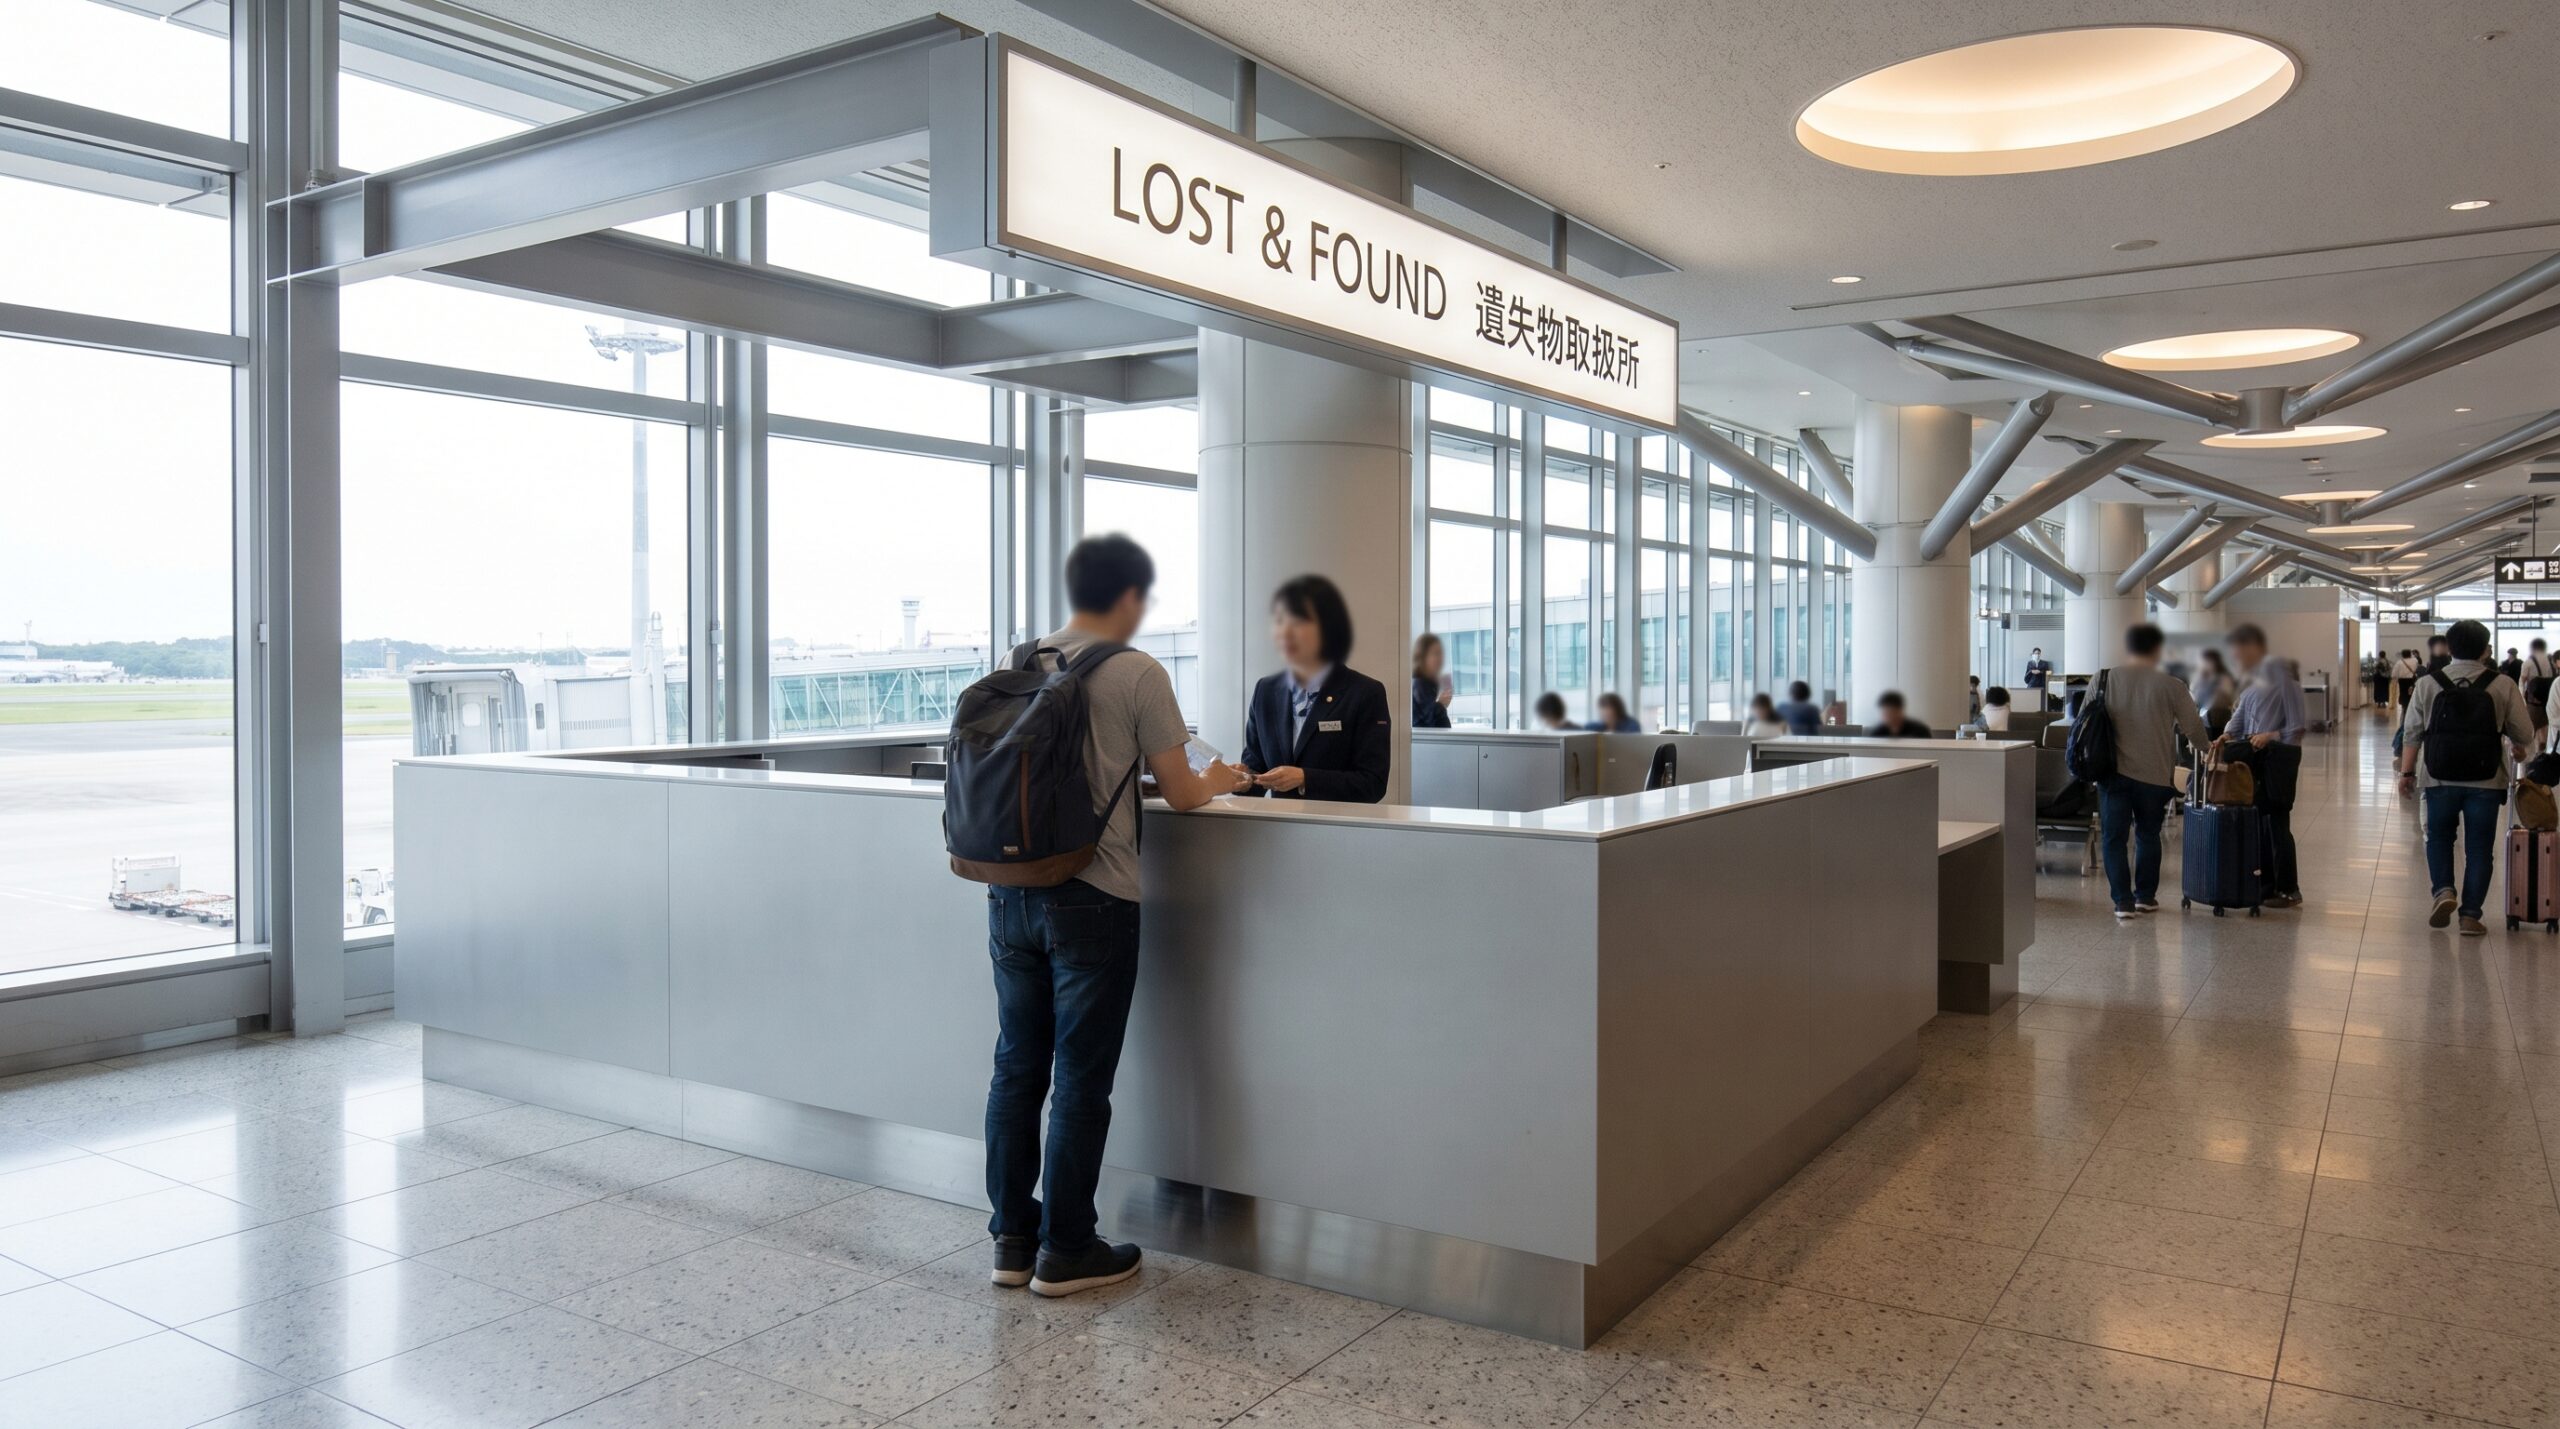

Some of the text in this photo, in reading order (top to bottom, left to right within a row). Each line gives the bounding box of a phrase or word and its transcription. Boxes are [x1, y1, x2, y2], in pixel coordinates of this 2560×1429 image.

[1113, 146, 1641, 389] LOST & FOUND 遺失物取扱所
